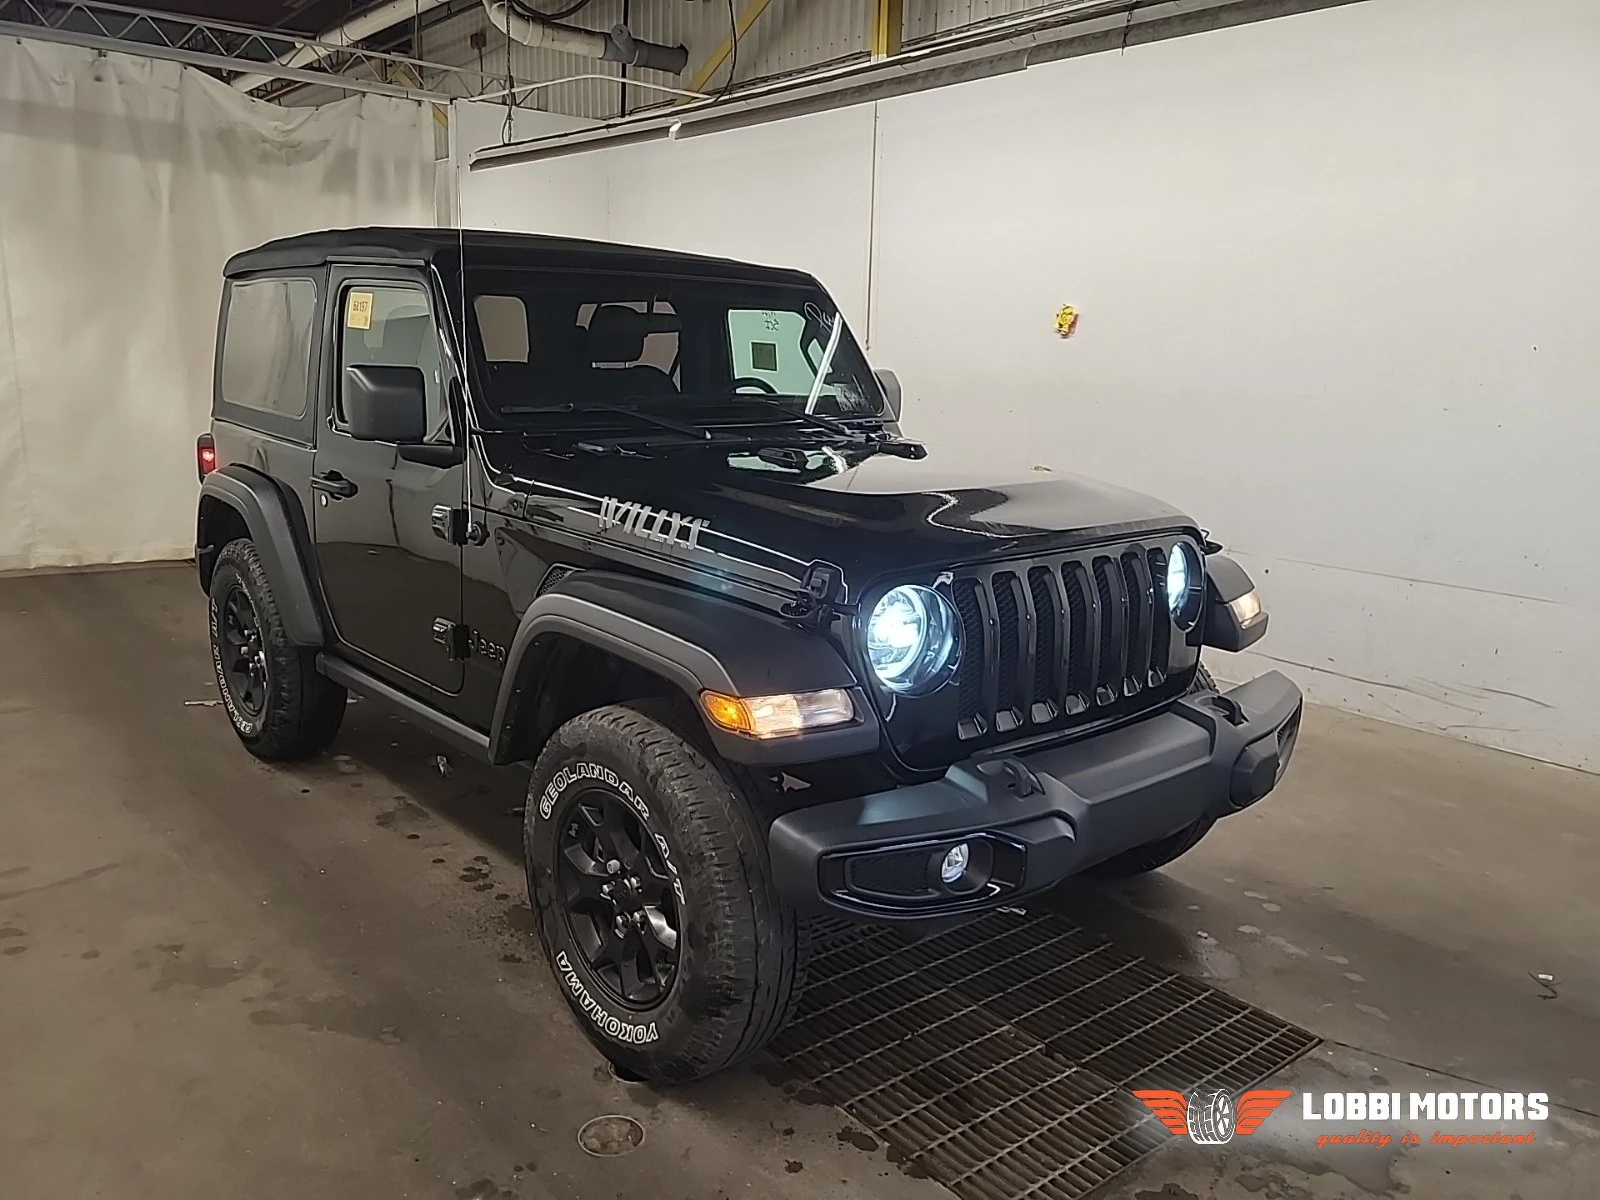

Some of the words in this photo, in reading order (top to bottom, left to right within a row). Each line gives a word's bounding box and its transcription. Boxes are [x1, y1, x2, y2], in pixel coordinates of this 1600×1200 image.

[598, 496, 711, 550] WILLYS
[468, 629, 506, 668] Jeep
[539, 762, 650, 821] GEOLANDAR
[556, 950, 660, 1044] YOKOHAMA
